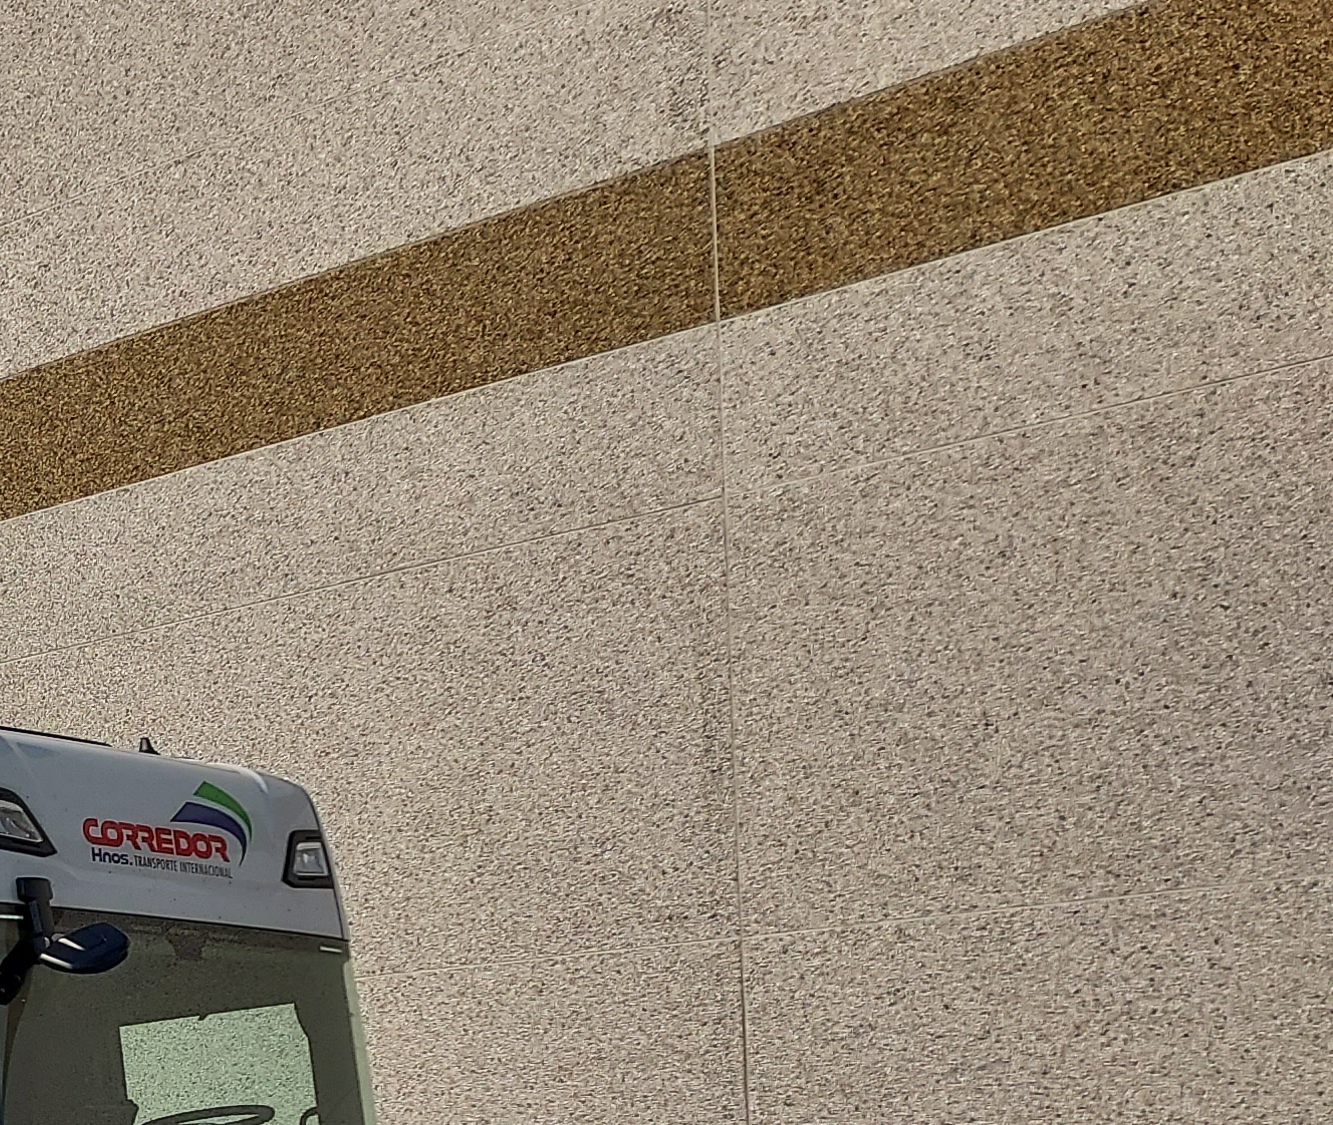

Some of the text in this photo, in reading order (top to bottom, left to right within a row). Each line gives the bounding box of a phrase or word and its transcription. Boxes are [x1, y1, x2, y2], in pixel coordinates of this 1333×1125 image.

[83, 818, 230, 862] CORREDOR
[91, 847, 233, 879] Hnos. TRANSPORTE INTERNACIONAL
